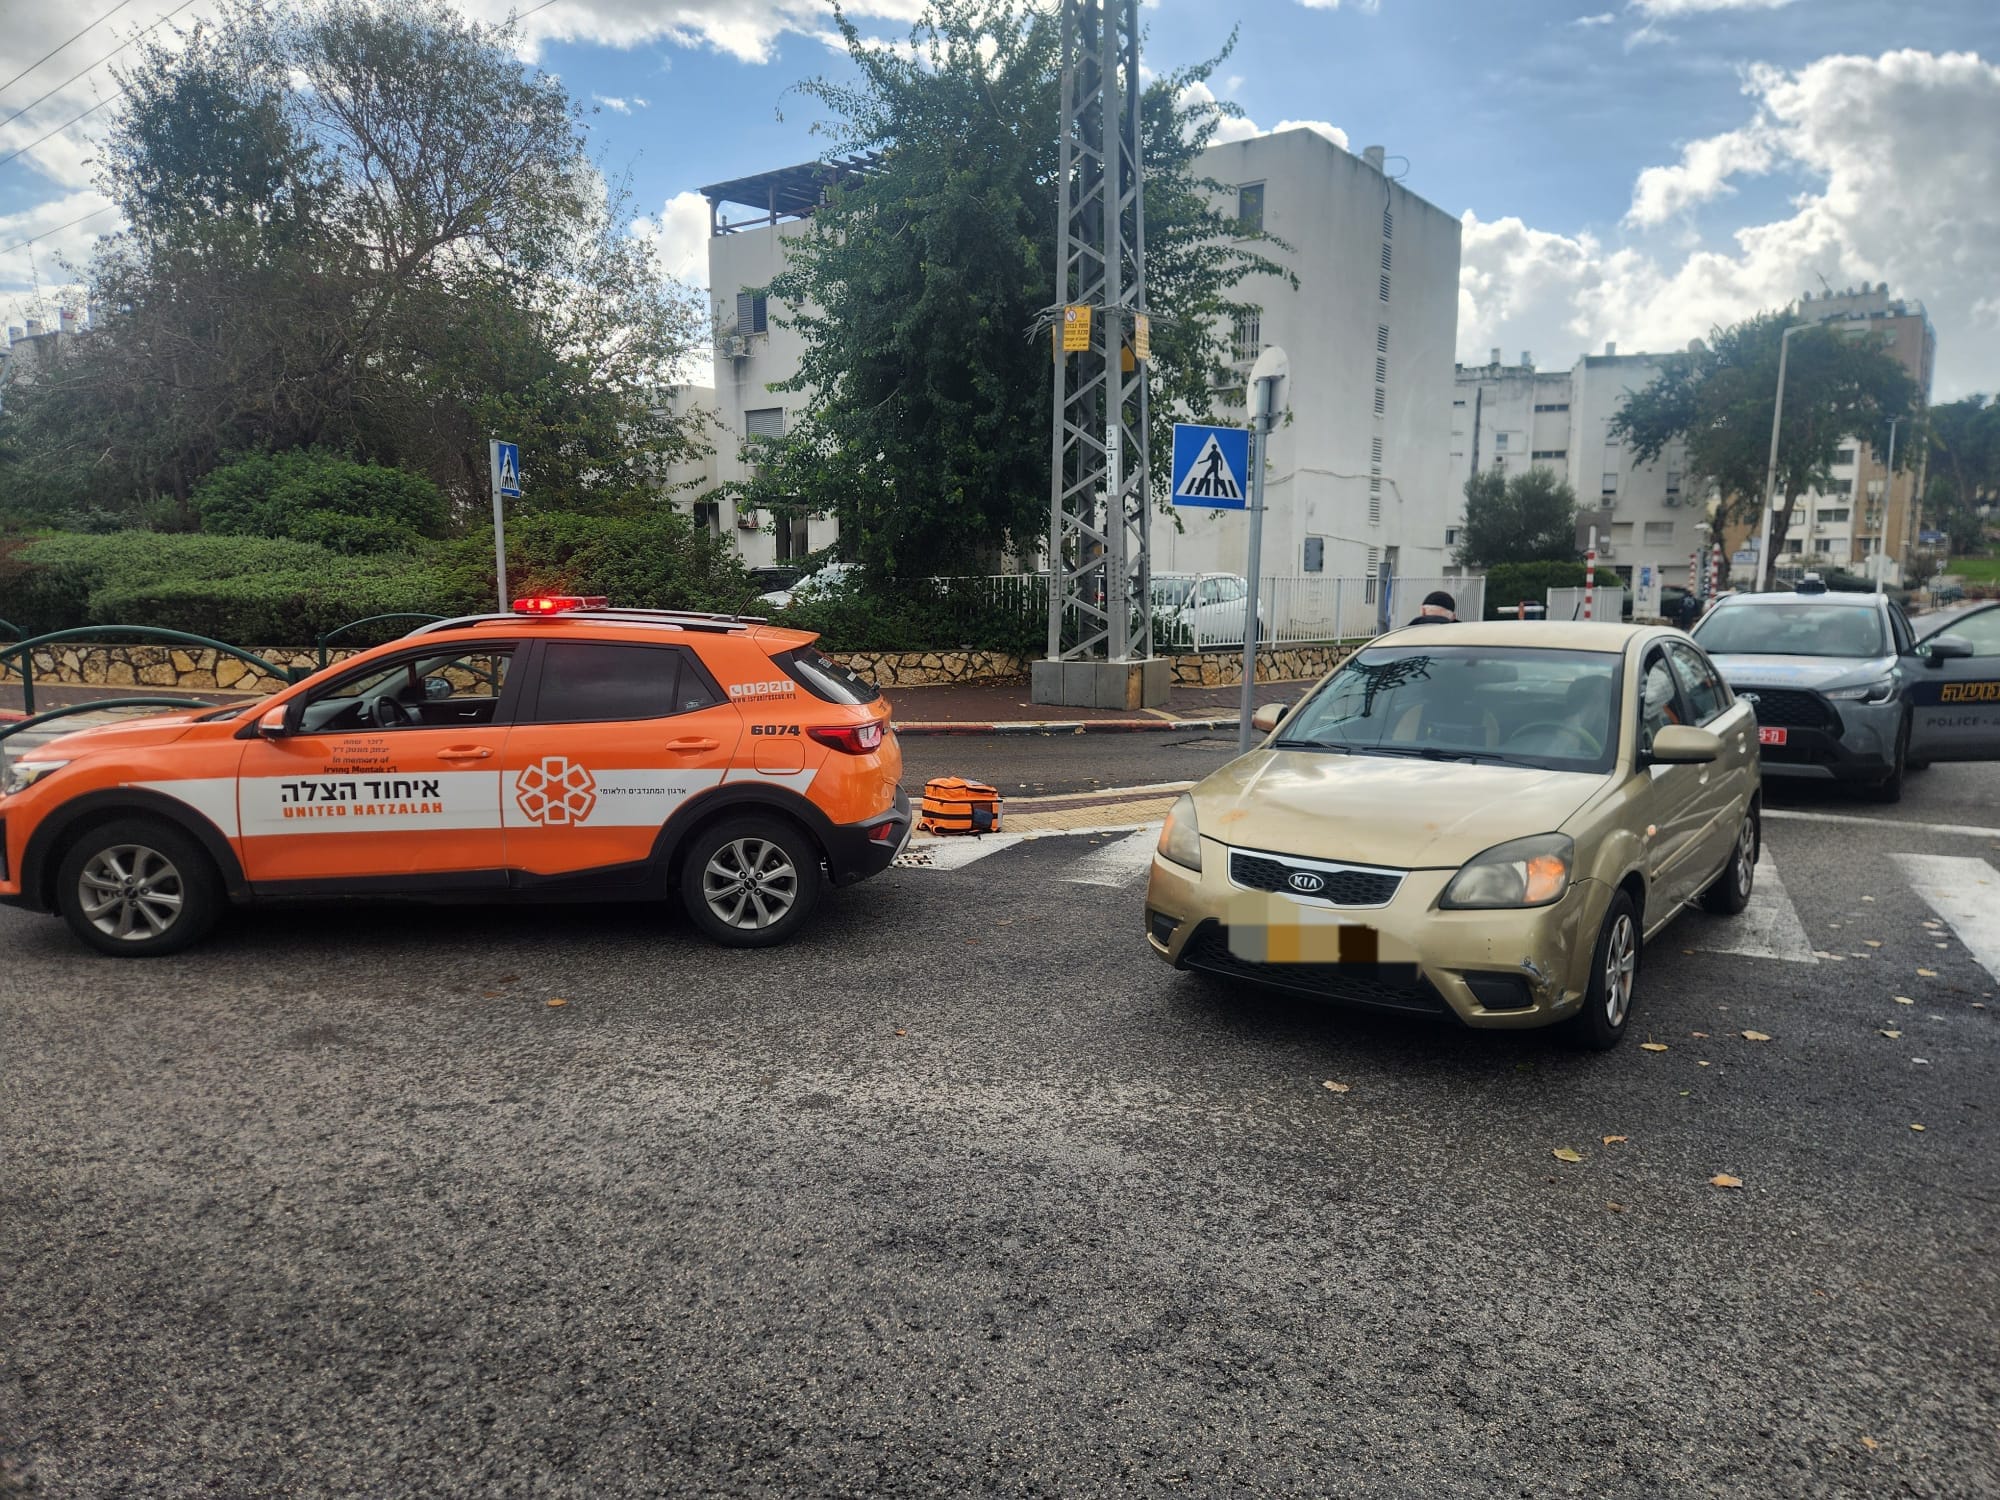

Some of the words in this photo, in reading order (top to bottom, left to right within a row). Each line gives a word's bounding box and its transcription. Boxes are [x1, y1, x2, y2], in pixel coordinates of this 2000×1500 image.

[744, 680, 793, 694] 1221
[751, 725, 800, 736] 6074
[281, 780, 357, 802] הצלה
[363, 779, 441, 799] איחוד
[600, 786, 626, 795] הלאומי
[667, 788, 687, 796] ארגון
[283, 805, 347, 818] UNITED
[353, 802, 443, 816] HATZALAH
[1294, 876, 1317, 888] KIA
